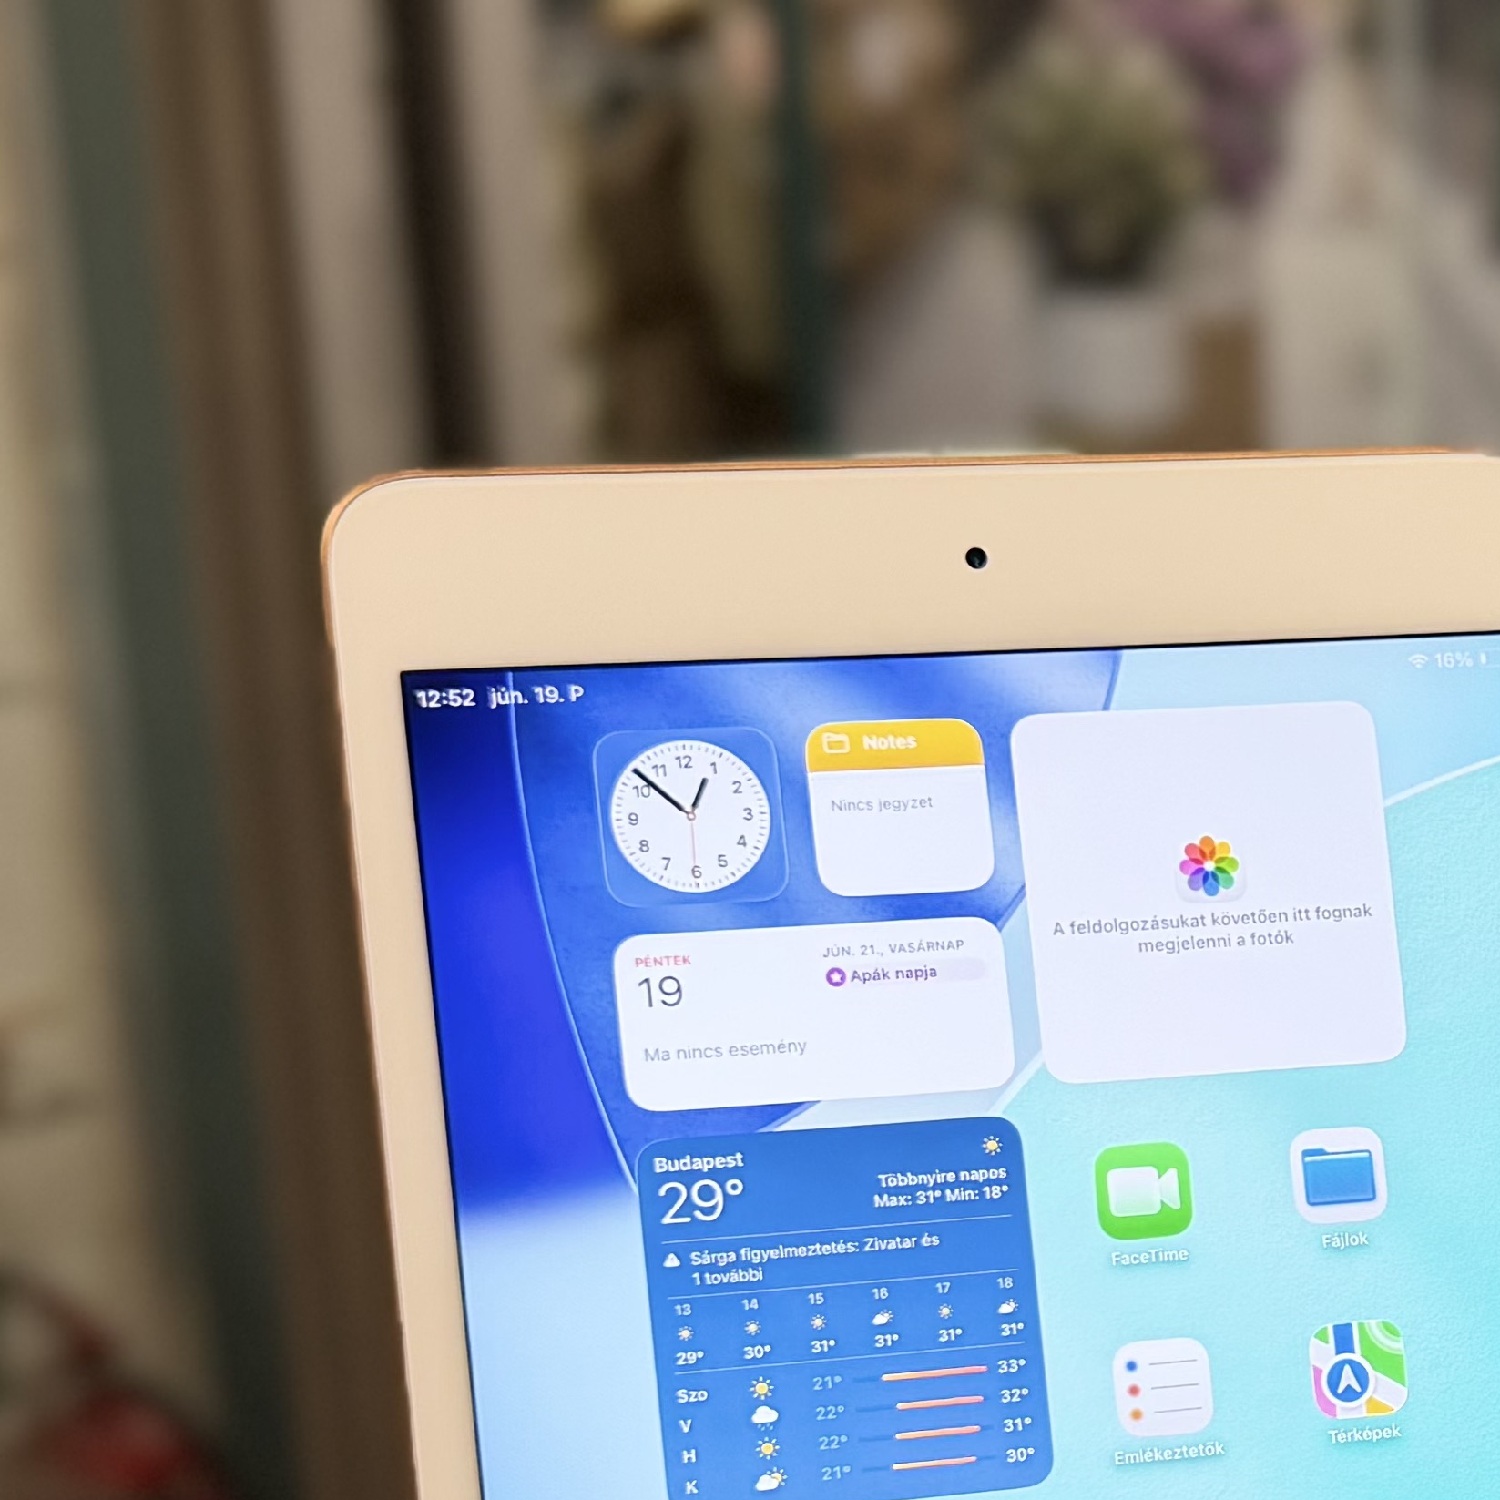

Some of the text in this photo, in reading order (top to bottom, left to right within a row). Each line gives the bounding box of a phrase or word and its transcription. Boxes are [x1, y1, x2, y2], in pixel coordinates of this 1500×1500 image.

[1433, 651, 1473, 669] 16%
[413, 689, 476, 708] 12:52
[533, 686, 565, 703] 19.
[569, 684, 584, 702] P
[862, 734, 917, 750] Notes
[675, 755, 693, 768] 12
[710, 762, 717, 774] 1
[652, 764, 667, 777] 11
[633, 784, 650, 798] 10
[732, 781, 742, 793] 2
[832, 797, 933, 812] Nincs jegyzet
[628, 812, 638, 825] 9
[743, 808, 753, 821] 3
[639, 840, 649, 852] 8
[737, 835, 747, 847] 4
[662, 857, 671, 870] 7
[718, 855, 728, 867] 5
[691, 865, 702, 878] 6
[1054, 904, 1373, 935] A feldolgozásukat követően itt fognak
[888, 939, 964, 953] VASÁRNAP
[1138, 930, 1294, 955] megjelenni a fotók
[635, 954, 691, 967] PÉNTEK
[851, 965, 937, 984] Apák napja
[638, 976, 682, 1007] 19
[645, 1039, 807, 1062] Ma nincs esemény
[654, 1152, 744, 1174] Budapest
[877, 1166, 1006, 1190] Többnyire napos
[873, 1193, 912, 1209] Max:
[945, 1187, 979, 1202] Min:
[1321, 1232, 1369, 1249] Fájlok
[689, 1233, 940, 1268] Sárga figyelmeztetés: Zivatar és
[1111, 1248, 1189, 1266] FaceTime
[692, 1267, 763, 1285] 1 további
[674, 1277, 1014, 1317] 13 14 15 16 17 18
[676, 1389, 709, 1404] Szo
[678, 1419, 693, 1434] V
[1328, 1424, 1402, 1444] Térképek
[682, 1449, 697, 1464] H
[1114, 1441, 1225, 1466] Emlékeztetők
[685, 1480, 699, 1495] K
